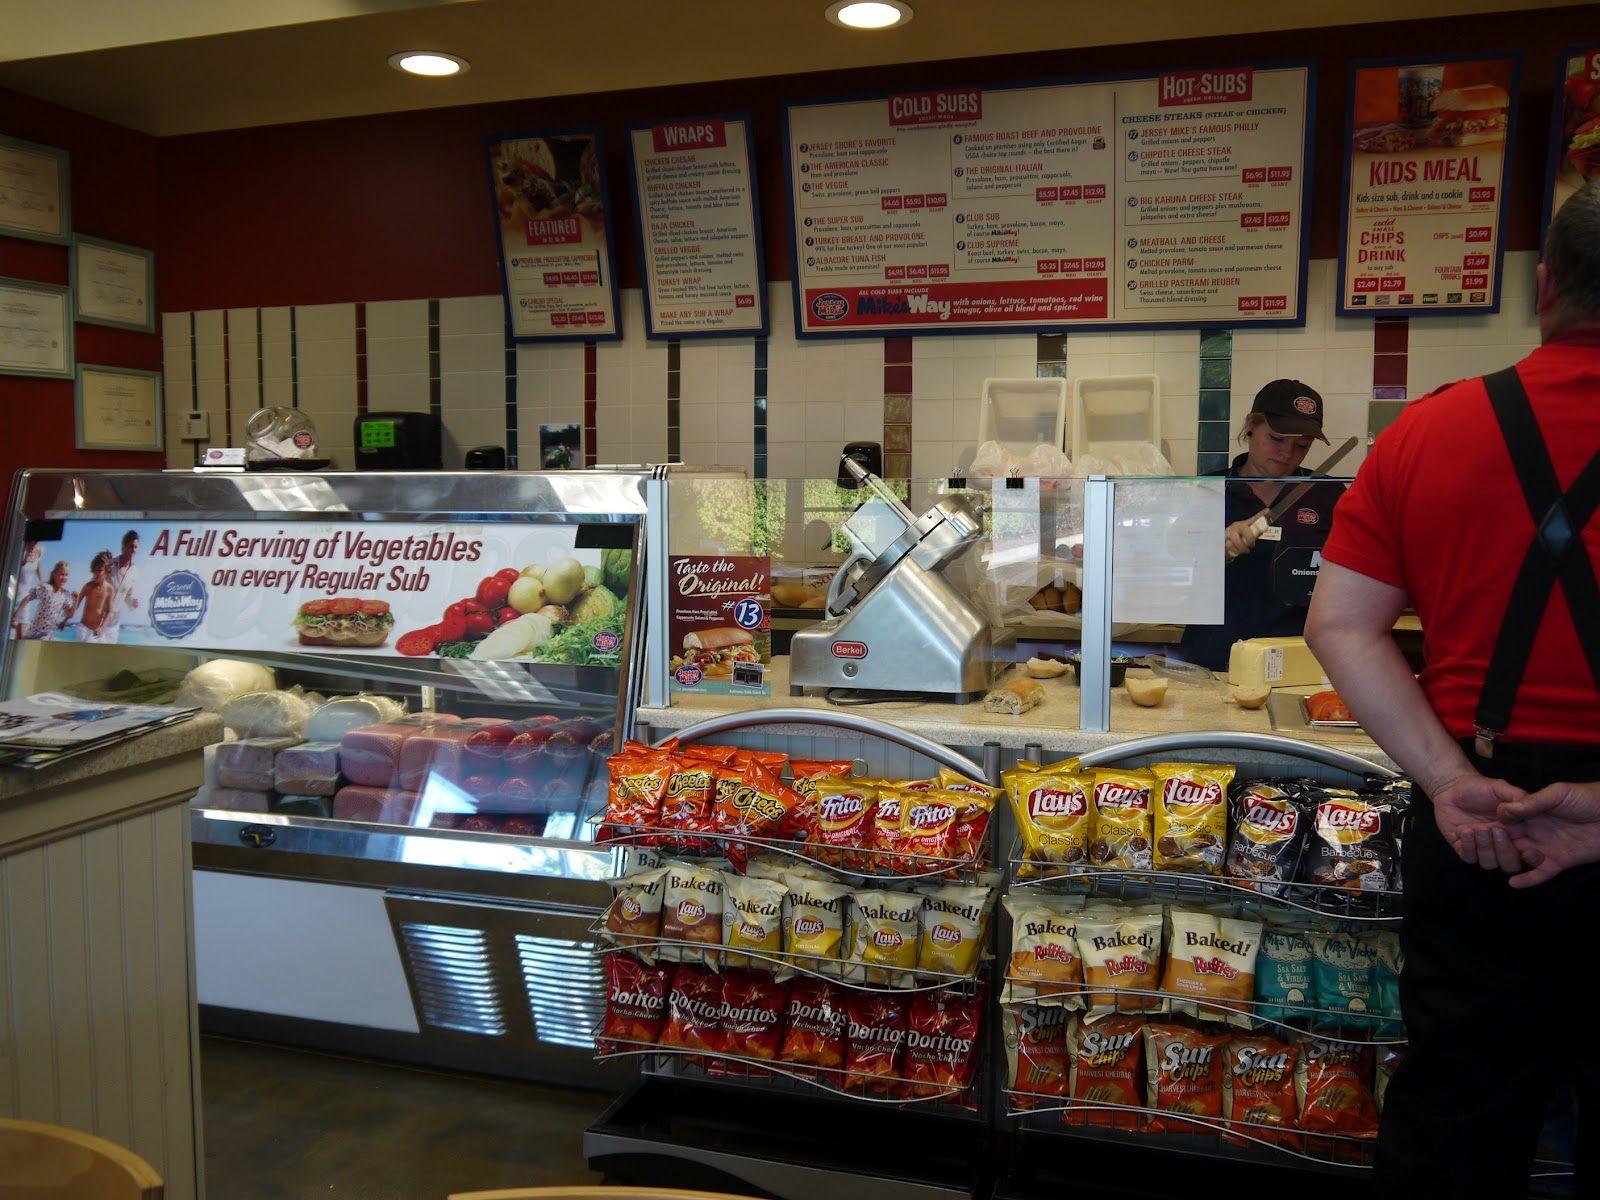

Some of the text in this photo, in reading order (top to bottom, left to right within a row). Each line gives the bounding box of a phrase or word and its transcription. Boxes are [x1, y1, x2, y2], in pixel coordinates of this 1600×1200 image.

[1163, 73, 1248, 100] HOT SUBS
[892, 92, 978, 118] COLD SUBS
[1122, 114, 1161, 124] CHEESE
[1164, 112, 1203, 122] STEAKS
[1205, 110, 1234, 120] (STEAK
[1246, 107, 1288, 117] CHICKEN)
[663, 124, 715, 146] WRAPS
[964, 126, 1103, 143] FAMOUS ROAST BEEF AND PROVOLONE
[1140, 122, 1261, 138] JERSEY MIKE'S FAMOUS PHILLY
[809, 138, 897, 152] JERSEY SHORE'S FAVORITE
[1140, 147, 1232, 160] CHIPOTLE CHEESE STEAK
[809, 157, 889, 171] THE AMERICAN CLASSIC
[965, 163, 1043, 175] THE ORIGINAL ITALIAN
[1369, 156, 1482, 187] KIDS MEAL
[1269, 170, 1290, 179] $11.95
[811, 181, 849, 191] THE VEGGIE
[1140, 191, 1244, 205] BIG KAHUNA CHEESE STEAK
[1356, 192, 1370, 203] Kids
[1371, 193, 1384, 203] size
[1385, 192, 1399, 203] sub,
[1401, 190, 1420, 202] drink
[1420, 191, 1434, 200] and
[1440, 190, 1463, 200] cookie
[669, 221, 695, 229] CHICKEN
[814, 215, 864, 226] THE SUPER SUB
[966, 212, 1000, 222] CLUB SUB
[1372, 217, 1398, 227] add
[527, 218, 577, 236] FEATURED
[814, 232, 925, 246] TURKEY BREAST AND PROVOLONE
[966, 239, 1019, 249] CLUB SUPREME
[1140, 234, 1226, 246] MEATBALL AND CHEESE
[1360, 231, 1405, 245] CHIPS
[816, 254, 886, 265] ALBACORE TUNA FISH
[1139, 258, 1195, 268] CHICKEN PARM
[1358, 249, 1406, 263] DRINK
[858, 288, 869, 296] ALL
[870, 288, 886, 296] COLD
[904, 287, 930, 295] INCLUDE
[1139, 277, 1241, 289] GRILLED PASTRAMI REUBEN
[1356, 279, 1402, 289] $2.49 $2.79
[906, 294, 951, 321] Way
[952, 294, 1104, 307] with onions, lettuce, tomatoes, red wine
[952, 303, 1079, 315] vinegar, olive oil blend and spices.
[1240, 299, 1285, 308] $6.95 $11.95
[660, 311, 678, 319] MAKE
[679, 310, 692, 318] ANY
[694, 310, 706, 318] SUB
[714, 309, 734, 317] WRAP
[149, 529, 484, 567] A Full Serving of Vegetables
[673, 557, 736, 575] Taste the
[210, 563, 431, 595] on every Regular Sub
[678, 572, 765, 600] Original!
[835, 645, 864, 656] Berkel
[665, 771, 714, 798] Cheetos
[732, 786, 786, 822] Cheetos
[909, 804, 956, 828] Fritos
[1100, 824, 1143, 837] Classic
[1038, 833, 1081, 846] Classic
[1233, 841, 1278, 862] Barbecue
[1320, 844, 1374, 859] Barbecue
[670, 876, 721, 896] Baked!
[789, 892, 838, 913] Baked!
[922, 897, 980, 922] Baked!
[859, 904, 915, 923] Baked!
[1091, 931, 1154, 951] Baked!
[1184, 931, 1251, 957] Baked!
[1105, 955, 1149, 978] Ruffles
[1193, 956, 1239, 980] Ruffles
[610, 987, 665, 1010] Doritos
[669, 989, 723, 1020] Doritos
[719, 1001, 778, 1024] Doritos
[791, 1000, 849, 1027] Doritos
[907, 1029, 972, 1053] Doritos
[1081, 1032, 1133, 1058] Sun
[1161, 1042, 1215, 1071] Sun
[1233, 1047, 1290, 1074] Sun
[1170, 1064, 1211, 1082] Chips
[1241, 1069, 1286, 1087] Chips
